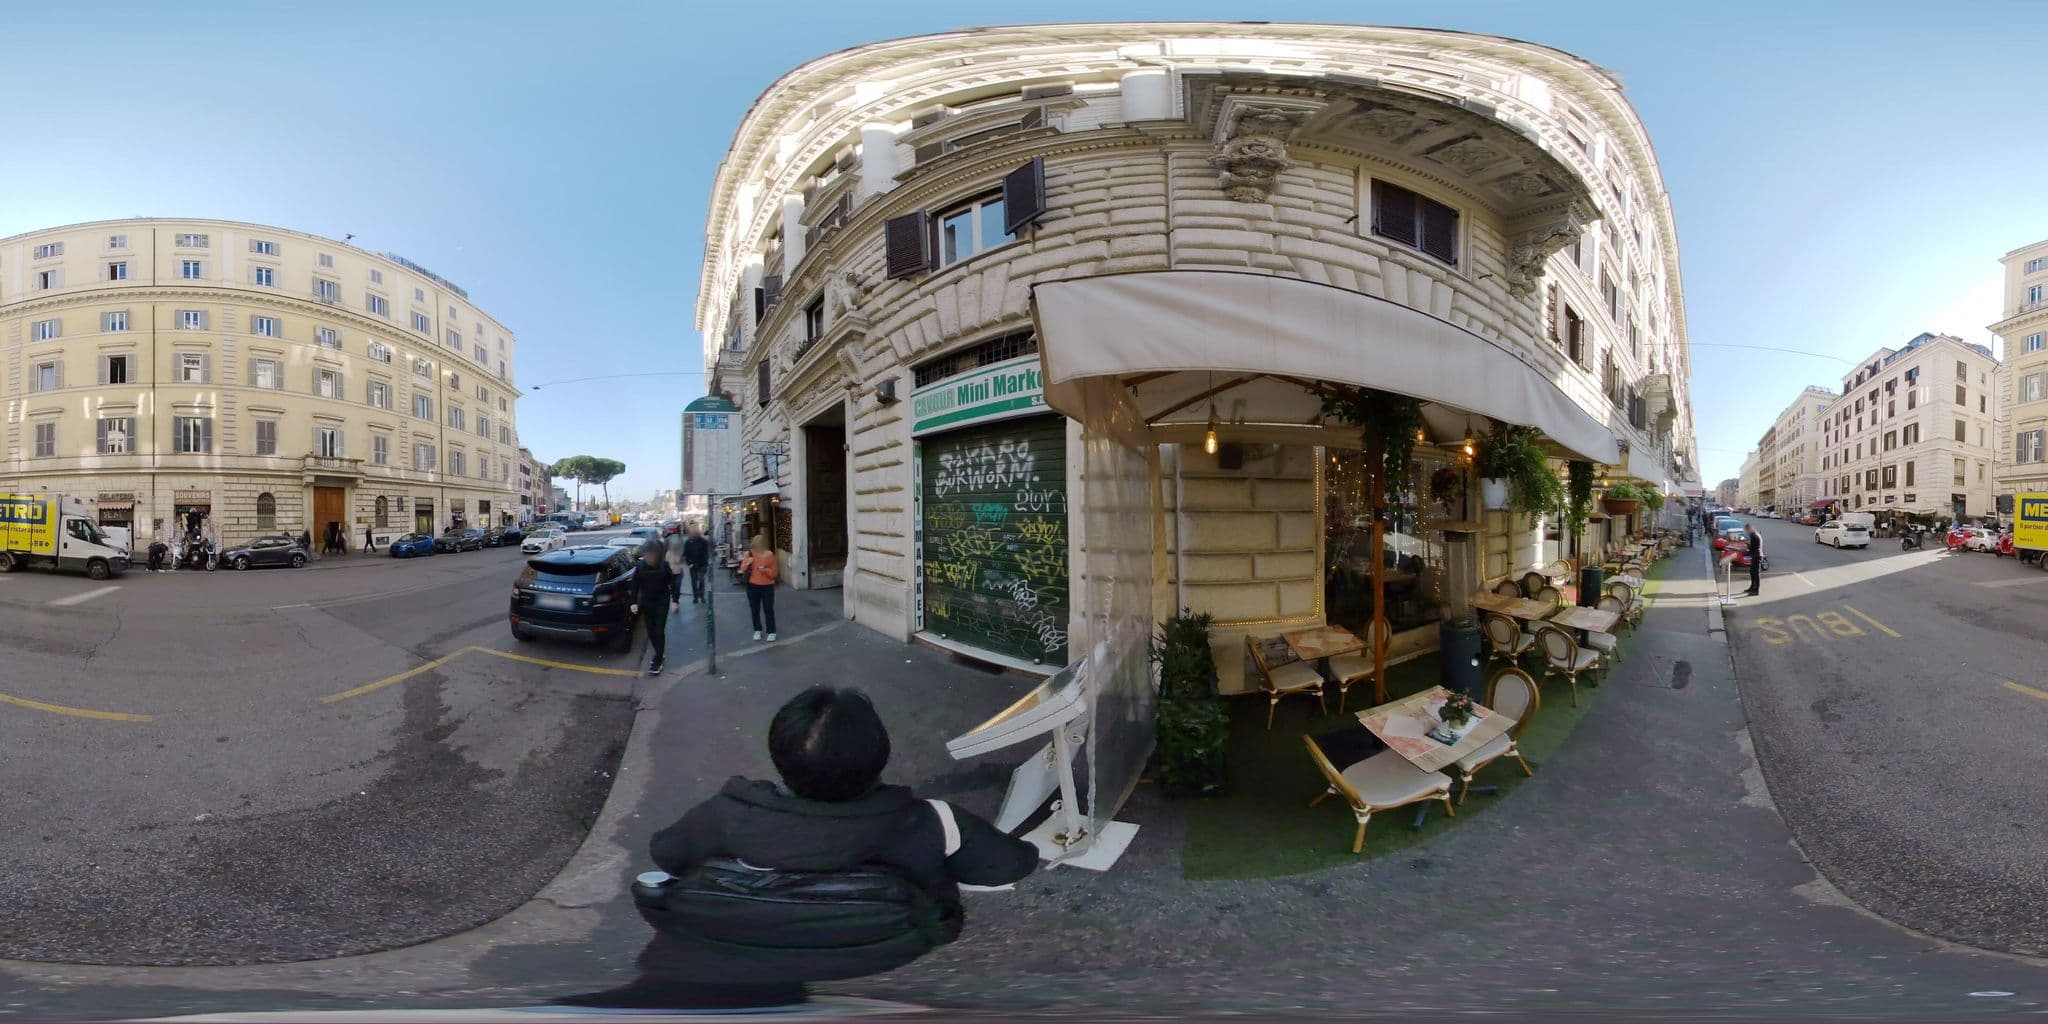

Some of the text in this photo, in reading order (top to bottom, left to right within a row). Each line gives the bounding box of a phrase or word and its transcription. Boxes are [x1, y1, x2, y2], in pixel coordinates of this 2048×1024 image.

[914, 368, 1043, 418] CAVOUR Mini Marke
[175, 490, 210, 499] SOUVENIRS
[0, 503, 43, 520] TRO
[914, 445, 923, 628] MINI MARKET
